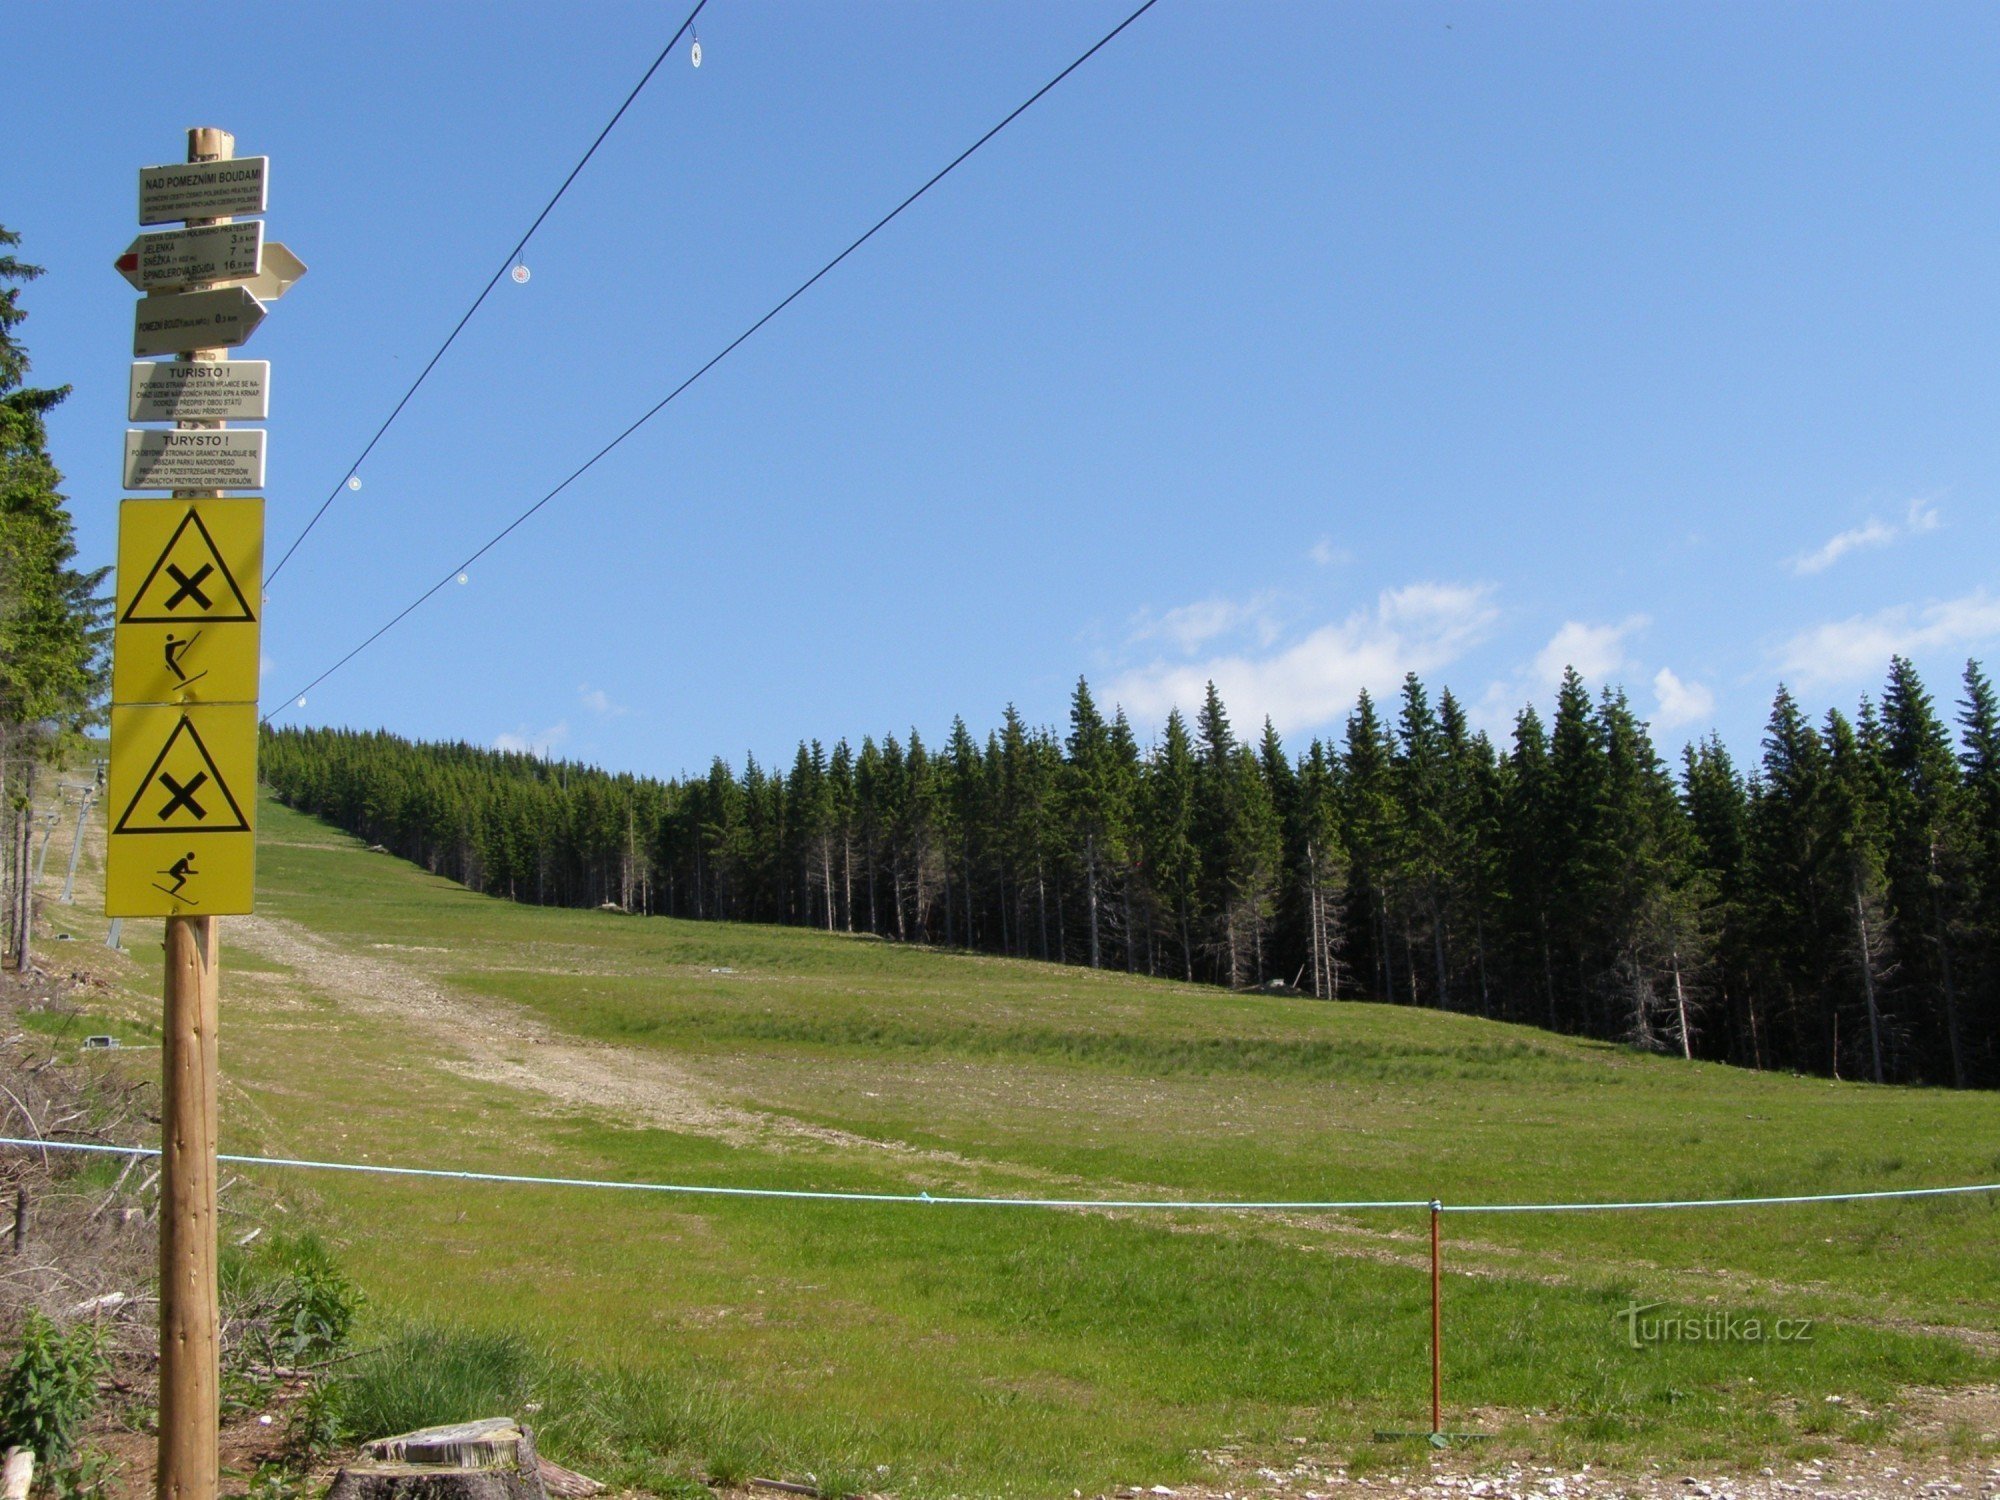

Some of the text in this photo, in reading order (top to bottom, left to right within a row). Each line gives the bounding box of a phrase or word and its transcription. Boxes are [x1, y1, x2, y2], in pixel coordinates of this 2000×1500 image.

[146, 178, 164, 190] NAD
[219, 169, 261, 183] BOUDAMI
[144, 242, 175, 254] JELENKA
[229, 247, 236, 256] 7
[191, 263, 215, 274] BOUDA
[169, 367, 223, 378] TURISTO
[163, 436, 229, 446] TURYSTO !
[195, 449, 219, 457] GRANICY
[177, 458, 195, 466] PARKU
[196, 458, 236, 466] NARODOWEGO
[163, 467, 169, 475] O
